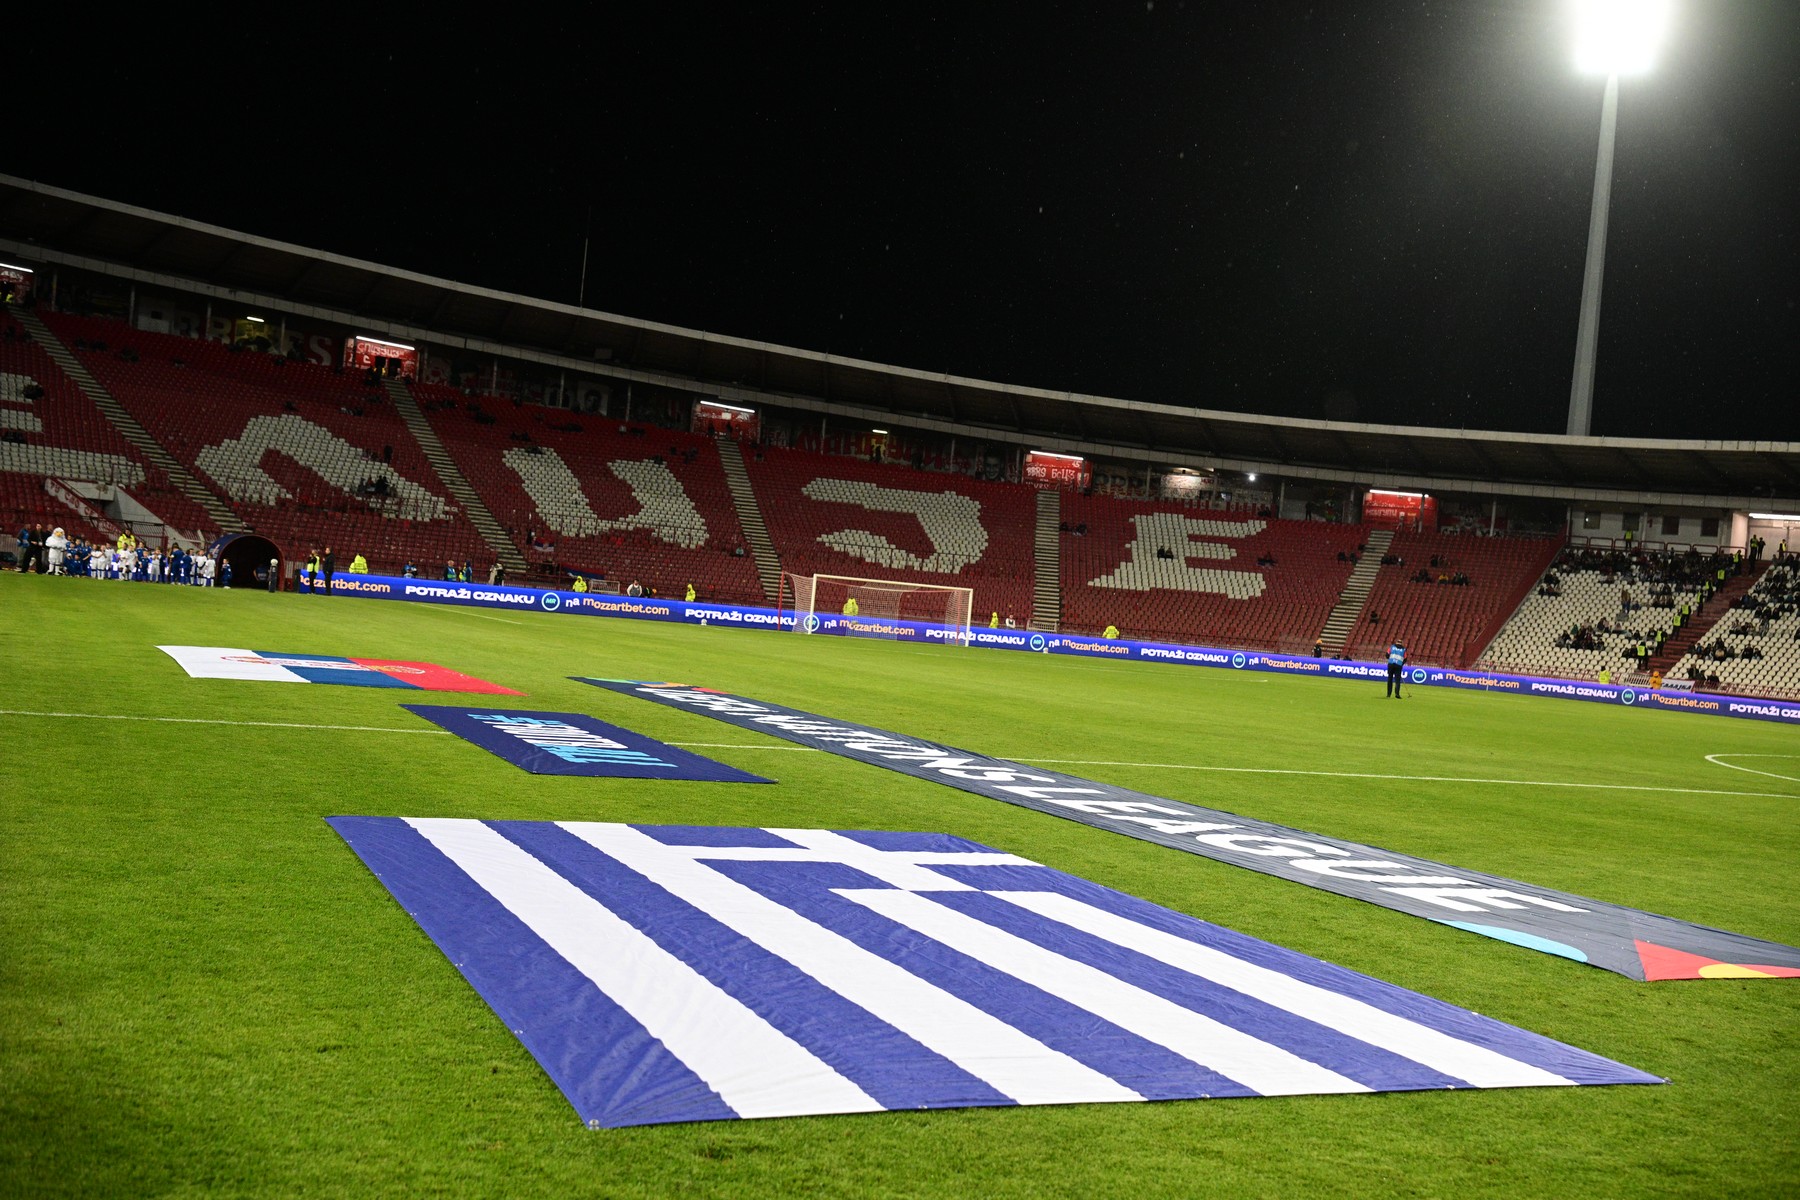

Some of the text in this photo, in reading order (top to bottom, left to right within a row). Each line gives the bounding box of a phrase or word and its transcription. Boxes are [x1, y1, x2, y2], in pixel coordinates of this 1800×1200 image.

[405, 585, 471, 599] POTRAŽI
[473, 591, 535, 604] OZNAKU
[565, 598, 580, 607] na
[583, 597, 670, 615] mozzartbet.com
[685, 608, 742, 621] POTRAŽI
[743, 614, 797, 625] OZNAKU
[824, 619, 837, 629] na
[839, 619, 915, 636] mozzartbet.com
[977, 634, 1025, 645] OZNAKU
[1048, 639, 1060, 648] na
[1062, 639, 1129, 654] mozzartbet.com
[1141, 648, 1185, 659] POTRAŽI
[1186, 652, 1228, 663] OZNAKU
[1249, 657, 1259, 665] na
[1261, 657, 1320, 671] mozzartbet.com
[1328, 664, 1368, 675] POTRAŽI
[1369, 668, 1408, 679] OZNU
[1431, 672, 1444, 681] na
[1446, 672, 1520, 688] mozzartbet.com
[1532, 683, 1575, 694] POTRAŽI
[1576, 688, 1618, 699] OZNAKU
[1639, 693, 1649, 702] na
[1651, 693, 1719, 710] mozzartbet.com
[1729, 703, 1779, 716] POTRAŽI
[723, 711, 1056, 782] NATIONS
[992, 785, 1591, 912] LEAGUE
